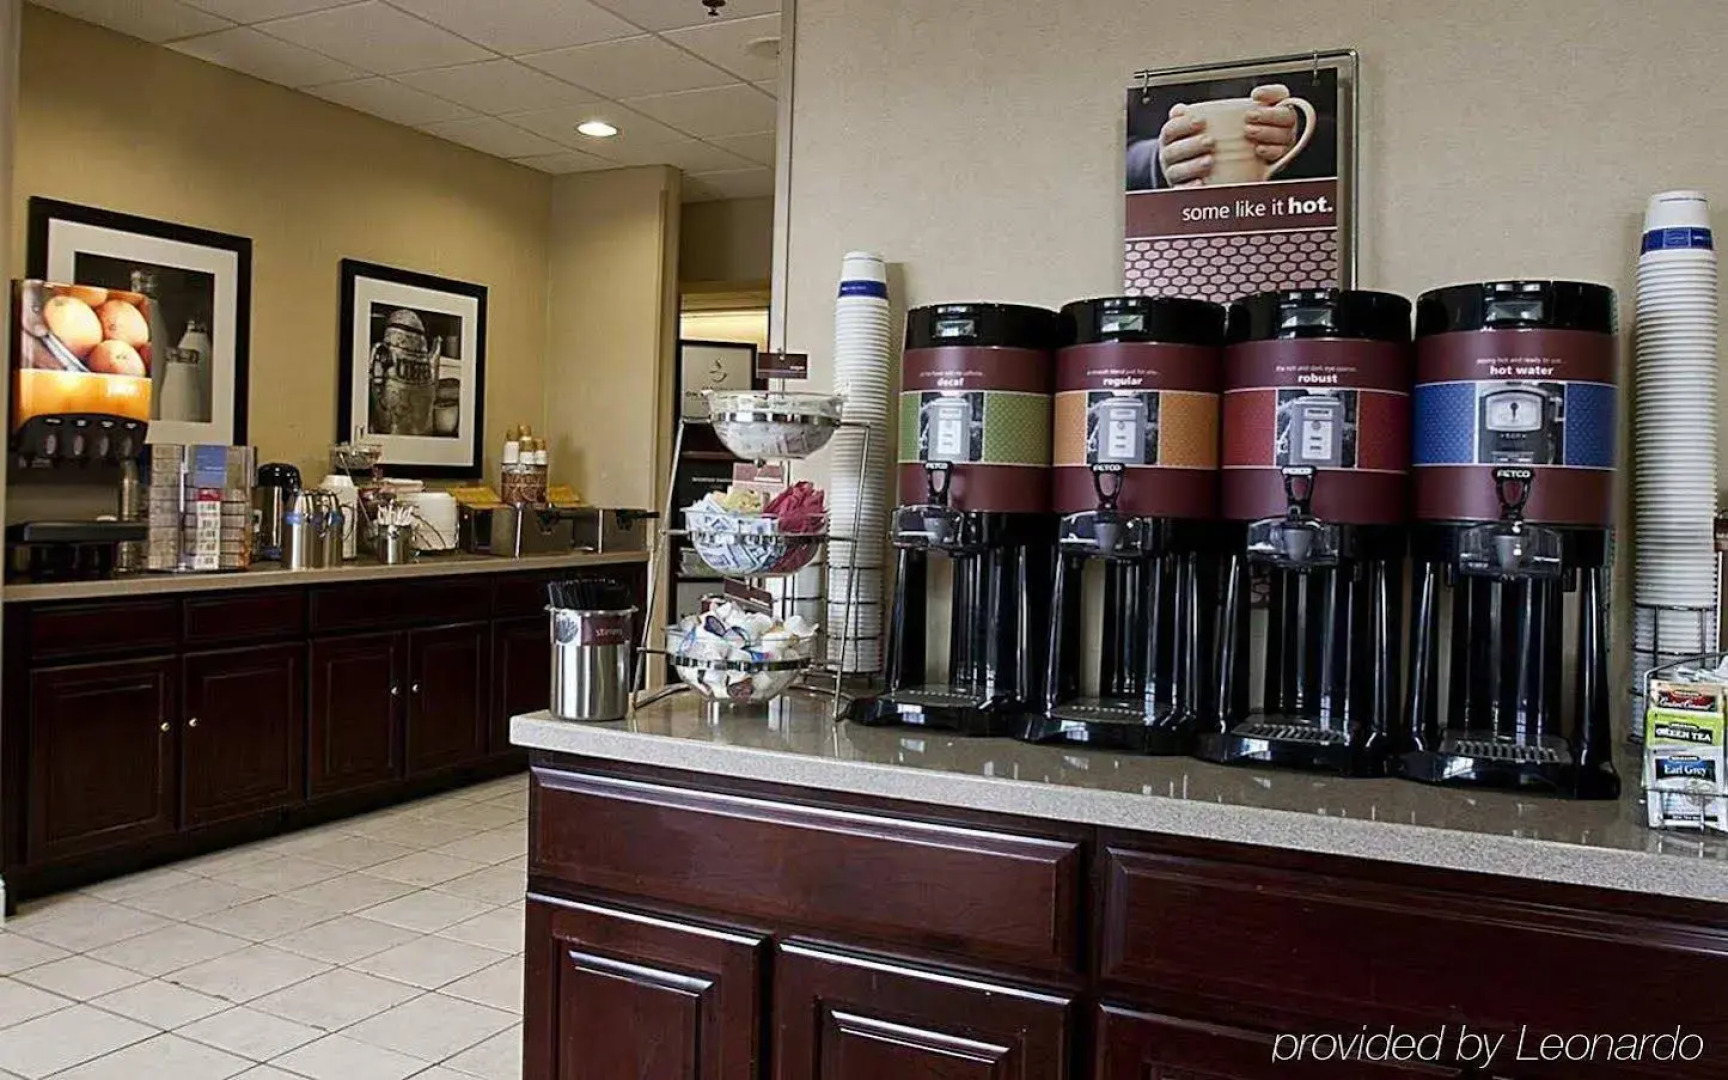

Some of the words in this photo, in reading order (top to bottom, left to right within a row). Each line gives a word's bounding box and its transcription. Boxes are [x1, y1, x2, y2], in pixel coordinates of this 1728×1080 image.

[1182, 205, 1230, 221] some
[1235, 200, 1266, 218] like
[1271, 199, 1284, 215] it
[1288, 196, 1333, 214] hot.
[1489, 365, 1512, 375] hot
[1515, 365, 1554, 375] water
[937, 376, 965, 387] decaf
[1103, 376, 1143, 388] regular
[1298, 372, 1338, 383] robust
[1497, 469, 1531, 478] FETCO
[1655, 727, 1690, 739] GREEN
[1691, 730, 1711, 742] TEA
[1664, 763, 1683, 774] Earl
[1684, 764, 1706, 776] Grey
